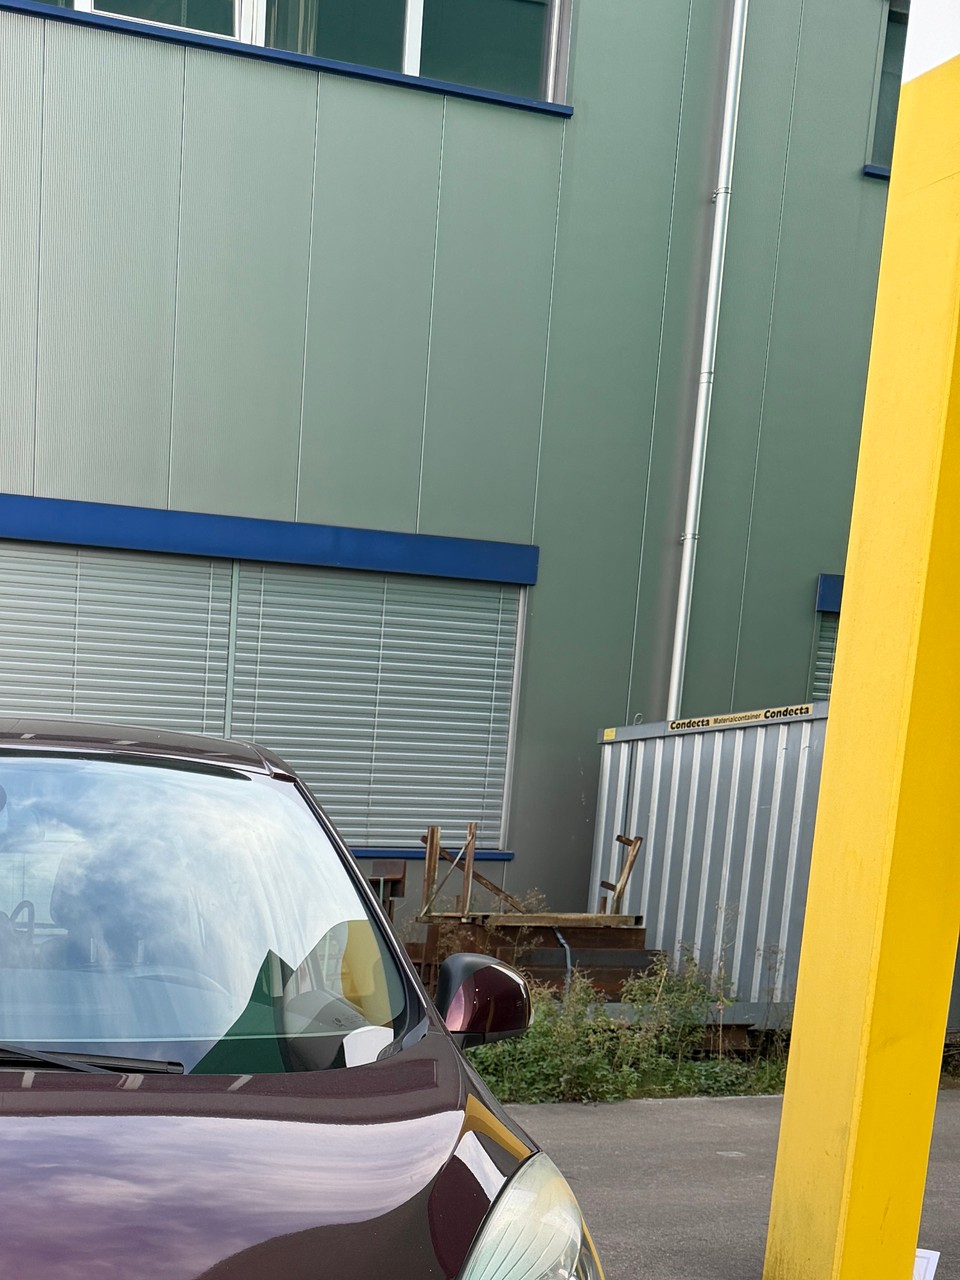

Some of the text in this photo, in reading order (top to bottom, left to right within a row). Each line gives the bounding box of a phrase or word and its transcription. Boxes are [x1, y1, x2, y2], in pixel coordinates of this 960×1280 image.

[670, 706, 810, 730] Condecta Materialcontainer Condecta
